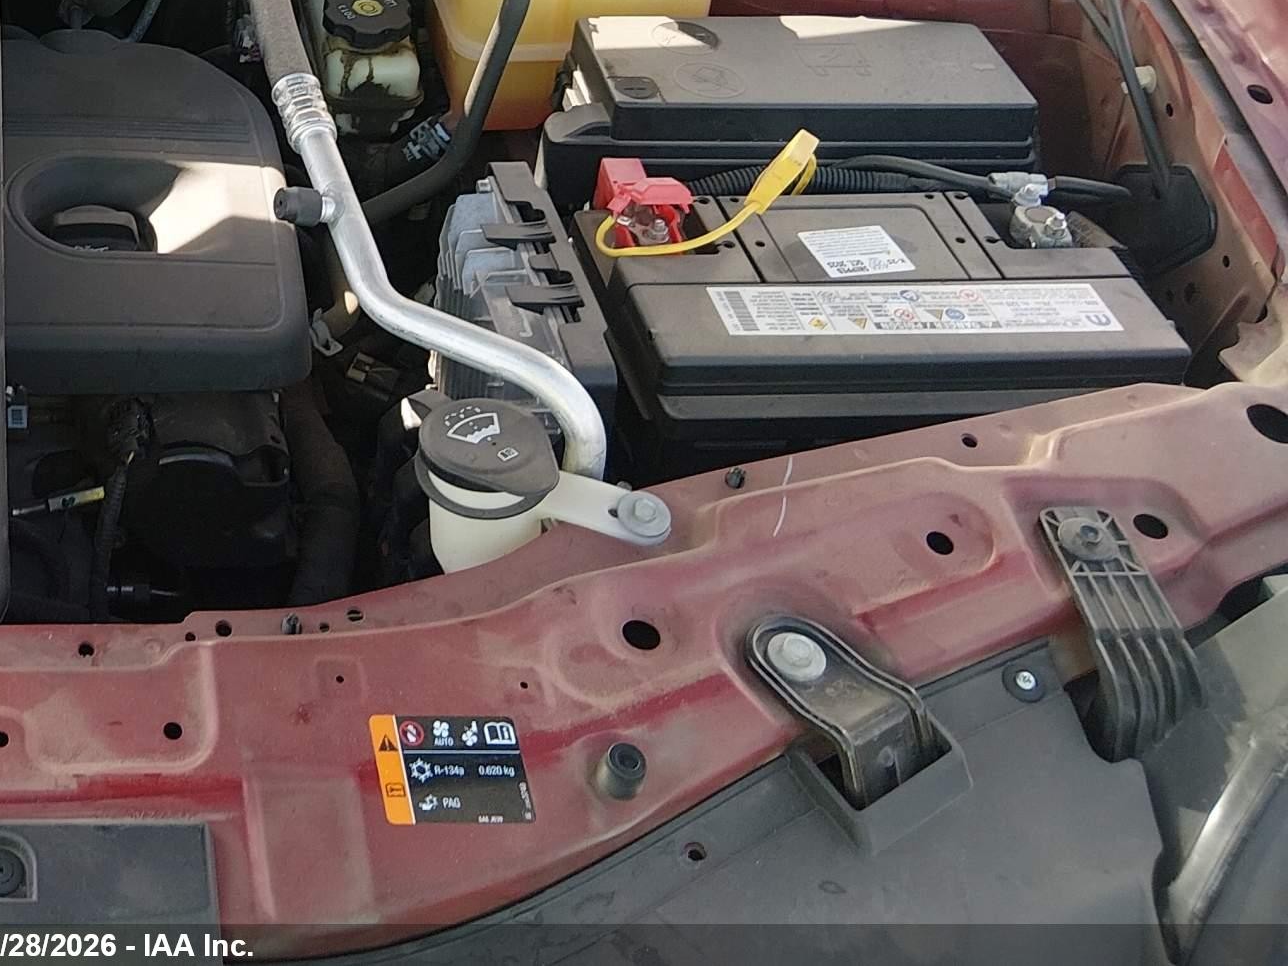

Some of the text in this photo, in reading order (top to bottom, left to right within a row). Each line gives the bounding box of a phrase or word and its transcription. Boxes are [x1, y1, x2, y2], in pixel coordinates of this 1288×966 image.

[433, 736, 454, 747] AUTO
[433, 764, 465, 777] R-134a
[503, 764, 515, 778] kg
[442, 796, 461, 809] PAG
